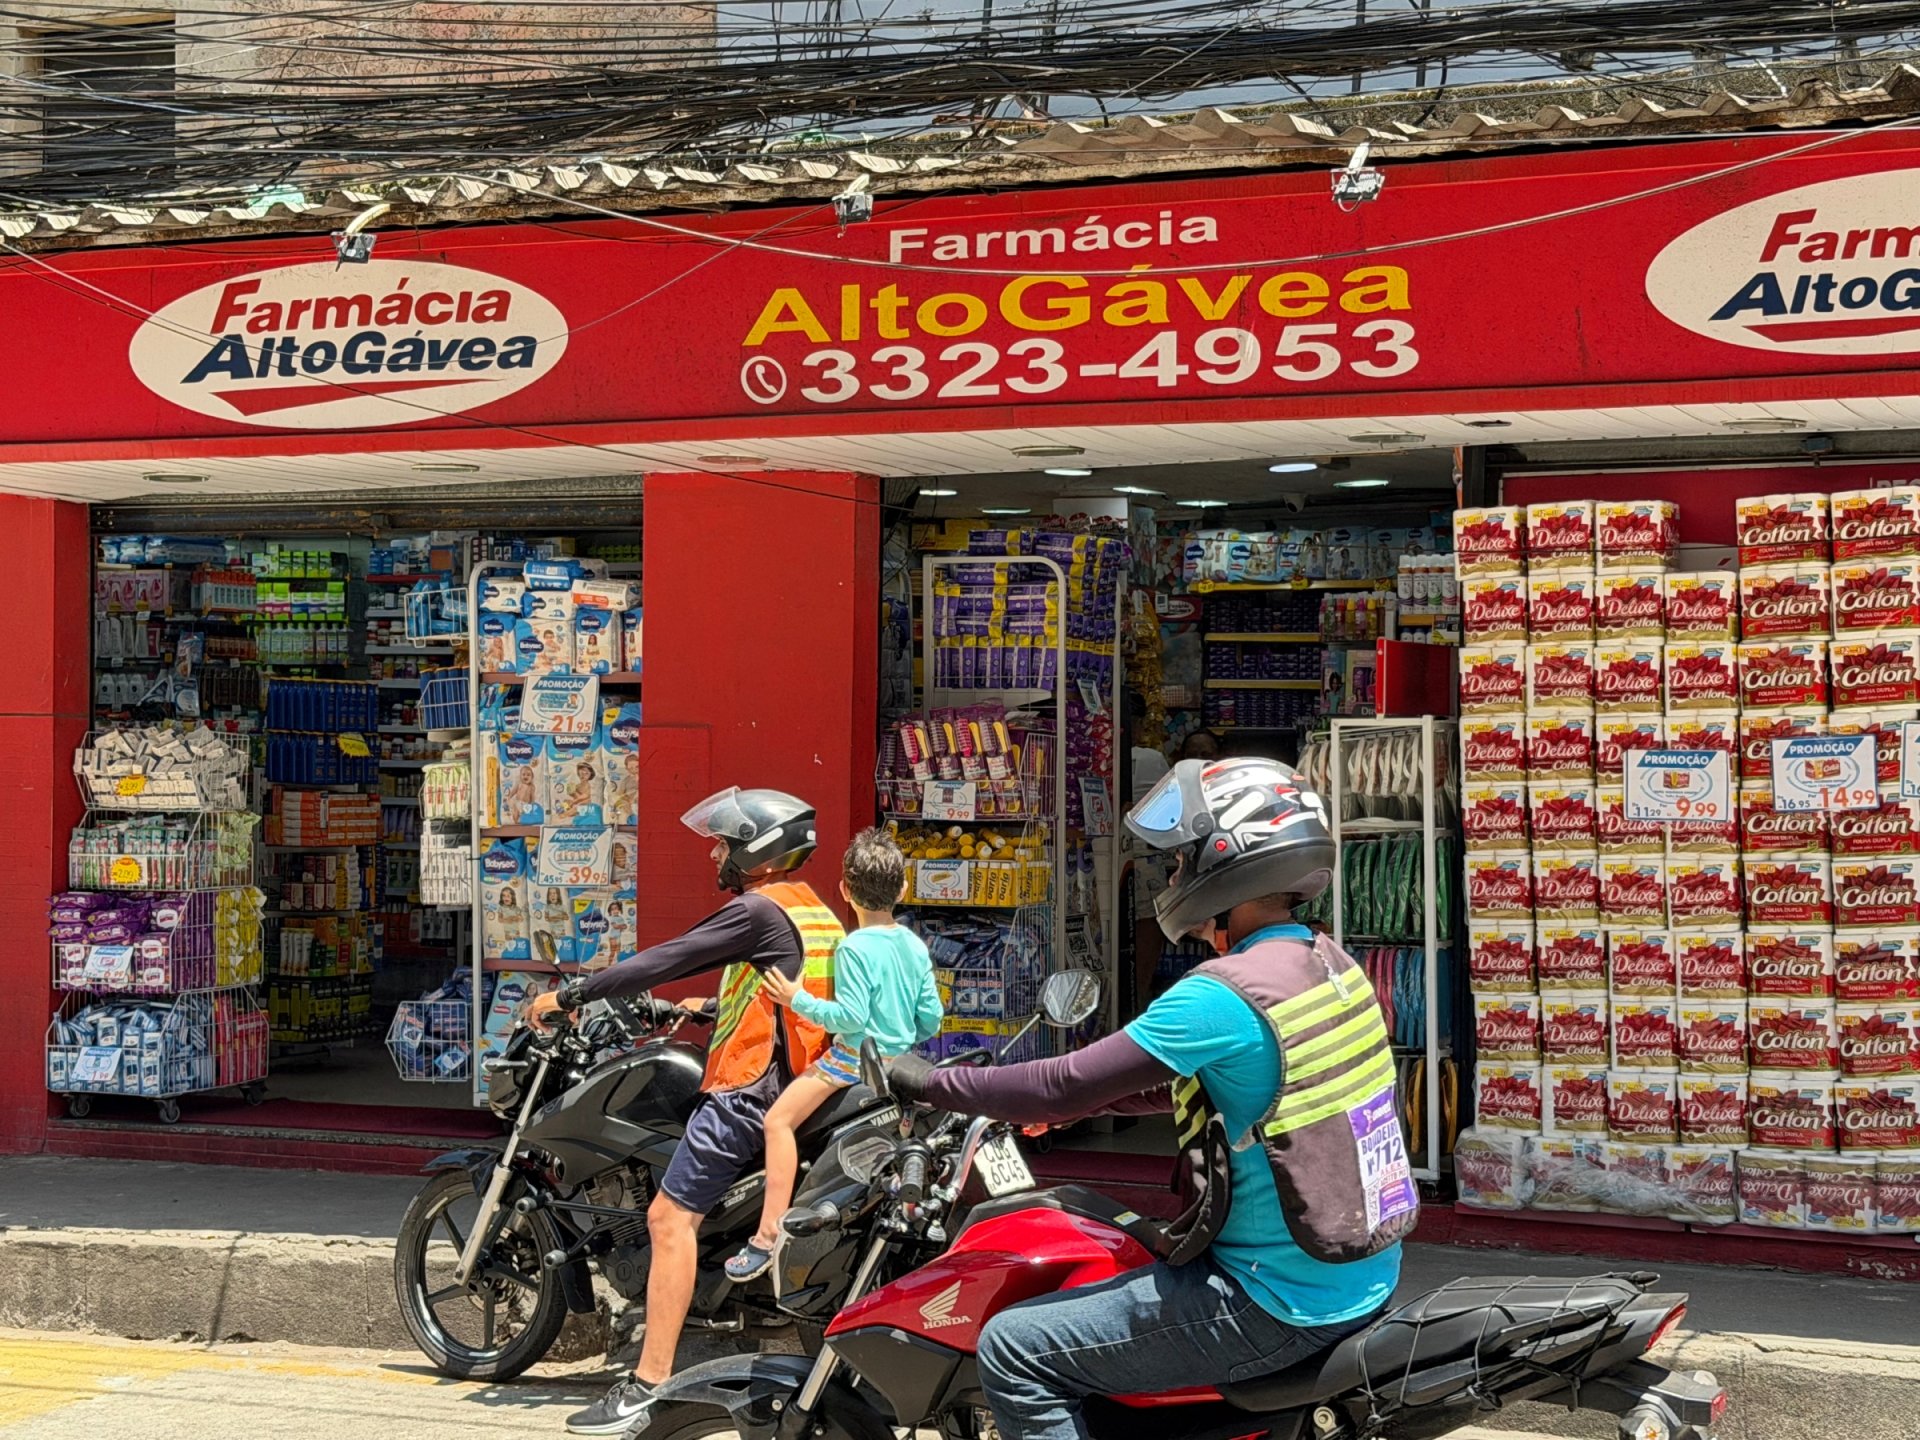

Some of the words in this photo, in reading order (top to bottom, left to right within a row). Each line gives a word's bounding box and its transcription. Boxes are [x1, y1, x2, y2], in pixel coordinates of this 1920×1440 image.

[889, 211, 1218, 263] Farmácia
[210, 278, 511, 334] Farmácia
[742, 264, 1412, 346] AltoGávea
[180, 330, 536, 384] AltoGávea
[801, 320, 1419, 402] 3323-4953
[1536, 529, 1585, 546] Deluxe
[1602, 529, 1654, 544] Deluxe
[1744, 527, 1810, 546] Cotton
[1840, 520, 1910, 539] Cotton
[1461, 535, 1507, 550] Deluxe
[1608, 600, 1657, 616] Deluxe
[1750, 599, 1817, 618] Cotton
[1839, 592, 1909, 610] Cotton
[1473, 604, 1520, 620] Deluxe
[1537, 605, 1586, 621] Deluxe
[1672, 603, 1722, 619] Deluxe
[1538, 668, 1586, 684] Deluxe
[1606, 676, 1654, 691] Deluxe
[1671, 670, 1723, 686] Deluxe
[1744, 668, 1812, 688] Cotton
[1842, 668, 1911, 687] Cotton
[538, 679, 584, 690] PROMOÇÃO
[1469, 676, 1517, 693] Deluxe
[556, 736, 588, 745] Babysec
[612, 729, 638, 738] Babys
[1468, 744, 1516, 760] Deluxe
[1536, 740, 1585, 756] Deluxe
[1790, 743, 1855, 755] PROMOÇÃO
[1645, 754, 1709, 766] PROMOÇÃO
[1473, 812, 1520, 828] Deluxe
[1540, 811, 1589, 827] Deluxe
[1748, 814, 1815, 832] Cotton
[1838, 818, 1907, 836] Cotton
[554, 832, 599, 841] PROMOÇÃO
[485, 858, 516, 869] Babysec
[1474, 880, 1520, 896] Deluxe
[1547, 880, 1594, 896] Deluxe
[1608, 885, 1657, 901] Deluxe
[1674, 886, 1724, 902] Deluxe
[1752, 887, 1819, 904] Cotton
[1842, 889, 1912, 907] Cotton
[1478, 954, 1525, 969] Deluxe
[1551, 950, 1599, 968] Deluxe
[1616, 955, 1664, 972] Deluxe
[1685, 959, 1734, 975] Deluxe
[1752, 959, 1818, 977] Cotton
[1837, 966, 1902, 983] Cotton
[1482, 1023, 1530, 1038] Deluxe
[1551, 1026, 1599, 1042] Deluxe
[1620, 1027, 1670, 1042] Deluxe
[1688, 1032, 1738, 1050] Deluxe
[1757, 1031, 1824, 1050] Cotton
[1841, 1038, 1906, 1056] Cotton
[1484, 1090, 1530, 1106] Deluxe
[1557, 1091, 1606, 1108] Deluxe
[870, 1109, 900, 1127] YAMA
[1618, 1103, 1668, 1120] Deluxe
[1689, 1104, 1740, 1121] Deluxe
[1846, 1109, 1912, 1130] Cotton
[1753, 1110, 1820, 1130] Cotton
[991, 1160, 1025, 1186] 6C45
[923, 1316, 972, 1330] HONDA
